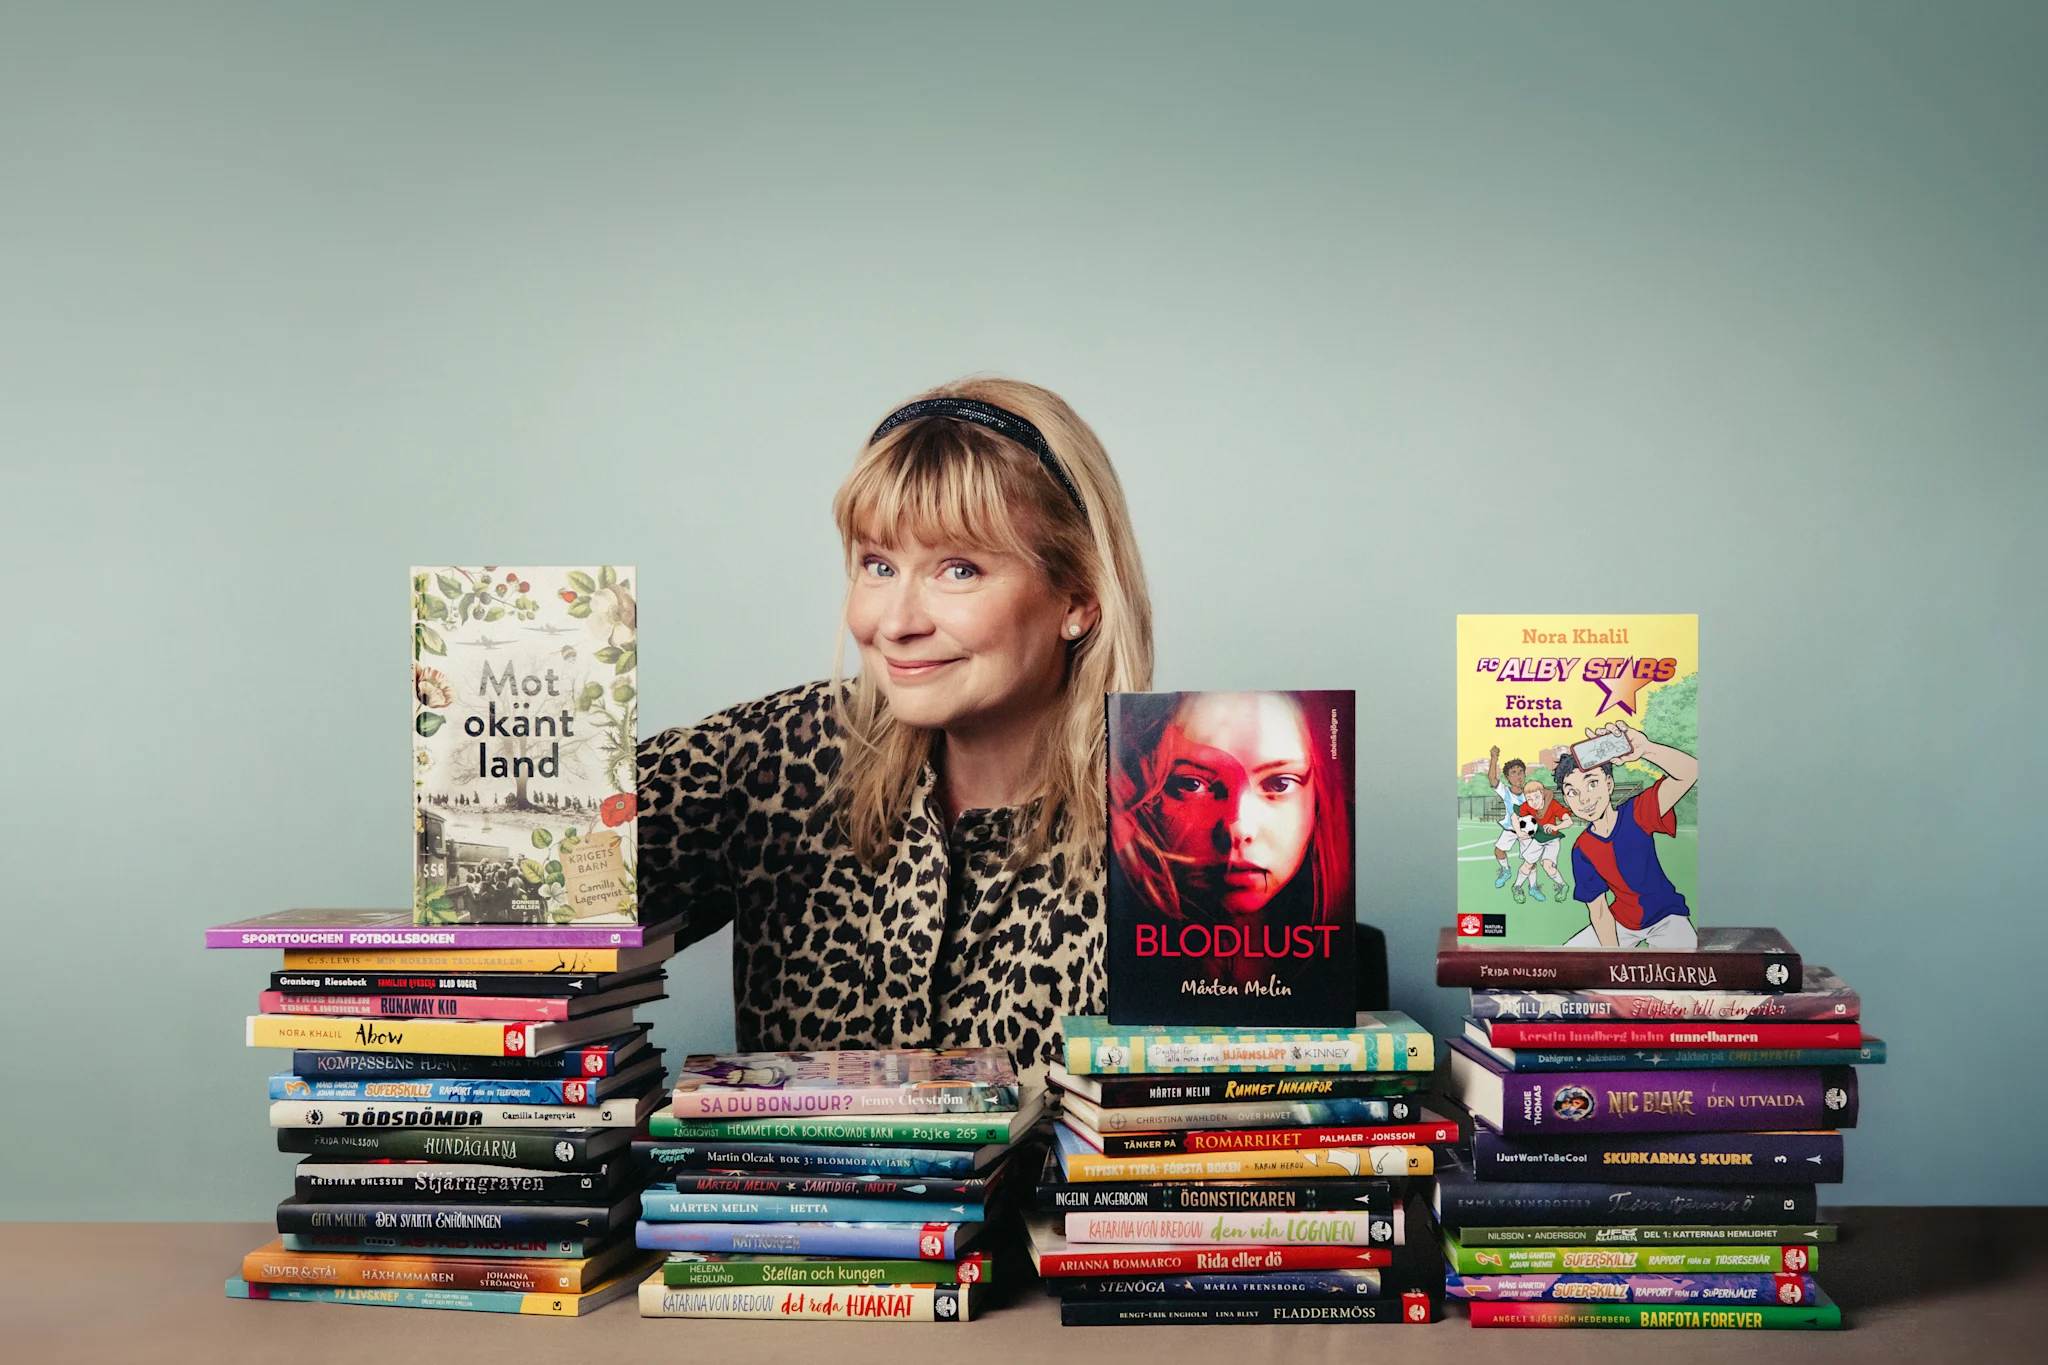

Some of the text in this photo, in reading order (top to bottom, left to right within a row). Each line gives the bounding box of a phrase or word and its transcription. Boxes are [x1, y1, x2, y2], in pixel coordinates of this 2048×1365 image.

[1522, 628, 1629, 644] Nora Khalil
[1477, 658, 1500, 672] FC
[1496, 657, 1581, 682] ALBY
[479, 660, 560, 696] Mot
[1505, 695, 1563, 710] Första
[464, 701, 575, 737] okänt
[1495, 713, 1573, 728] matchen
[479, 742, 559, 778] land
[568, 849, 614, 865] KRIGETS
[578, 861, 608, 874] BARN
[579, 880, 615, 894] Camilla
[574, 889, 623, 906] Lagerqvist
[241, 933, 455, 944] SPORTTOUCHEN FOTBOLLSBOKEN
[1135, 924, 1340, 959] BLODLUST
[1480, 965, 1557, 978] FRIDA NILSSON
[280, 977, 367, 987] Granberg Riesebeck
[1181, 974, 1292, 997] Mårten Melin
[279, 1004, 371, 1014] TONE LINDHOLM
[380, 997, 457, 1015] RUNAWAY KID
[1693, 998, 1715, 1017] till
[279, 1023, 403, 1046] NORA KHALIL Abow
[1520, 1031, 1758, 1043] kerstin lundberg hahn tunnelbarnen
[1203, 1047, 1350, 1063] fans HJÄRNSLÄPP KINNEY
[1538, 1051, 1710, 1064] Dahlgren Jakobsson Jakten
[317, 1056, 565, 1071] KOMPASSENS ANNA THULIN
[364, 1082, 433, 1098] SUPERSKILLZ
[1149, 1079, 1333, 1099] MÅRTEN MELIN RUMMET INNANFÖR
[727, 1093, 963, 1113] DU BONJOUR? Jenny Clevström
[1523, 1090, 1533, 1121] ANGIE
[1533, 1085, 1805, 1126] THOMAS NIC BLAKE DEN UTVALDA
[338, 1106, 576, 1127] DÖDSDÖMDA Camilla Lagerqvist
[1136, 1111, 1291, 1125] CHRISTINA HAVET
[727, 1124, 978, 1140] HEMMET FÖR BARN Pojke 265
[314, 1134, 517, 1160] FRIDA NILSSON HUNDÄGARNA
[1123, 1131, 1416, 1150] TÄNKER PÅ ROMARRIKET PALMAER JONSSON
[706, 1151, 911, 1168] Martin Olczak BOK BLOMMOR AV JÄRN
[1254, 1162, 1278, 1170] KARIN
[1496, 1152, 1788, 1166] IJustWantToBeCool SKURKARNAS SKURK 3
[310, 1171, 545, 1194] KRISTINA OHLSSON Stjärngraven
[696, 1179, 781, 1192] MÅRTEN MELIN
[1055, 1189, 1296, 1207] INGELIN ANGERBORN ÖGONSTICKAREN
[669, 1202, 828, 1213] MÅRTEN MELIN HETTA
[311, 1211, 432, 1229] GITA DEN SVARTA
[1089, 1216, 1284, 1241] KATARINA VON BREDOW den vita
[1488, 1230, 1778, 1240] NILSSON ANDERSSON DEL KATTERNAS HEMLIGHET
[1058, 1251, 1282, 1272] ARIANNA BOMMARCO Rida eller dö
[1563, 1251, 1686, 1268] SUPERSKILLZ RAPPORT
[362, 1269, 454, 1283] HÄXHAMMAREN
[486, 1271, 529, 1280] JOHANNA
[689, 1264, 885, 1282] HELENA Stellan och kungen
[689, 1274, 734, 1284] HEDLUND
[479, 1279, 536, 1289] STRÖMQVIST
[1099, 1279, 1306, 1293] STENÖGA MARIA FRENSBORG
[1552, 1282, 1673, 1299] SUPERSKILLZ RAPPORT
[348, 1289, 400, 1302] LIVSKNEP
[662, 1292, 805, 1315] KATARINA VON BREDOW det
[1119, 1311, 1167, 1319] BENGT-ERIK
[1169, 1311, 1208, 1319] ENGHOLM
[1273, 1306, 1376, 1319] FLADDERMÖSS
[1529, 1312, 1762, 1327] SJÖSTRÖM HEDERBERG BARFOTA FOREVER
